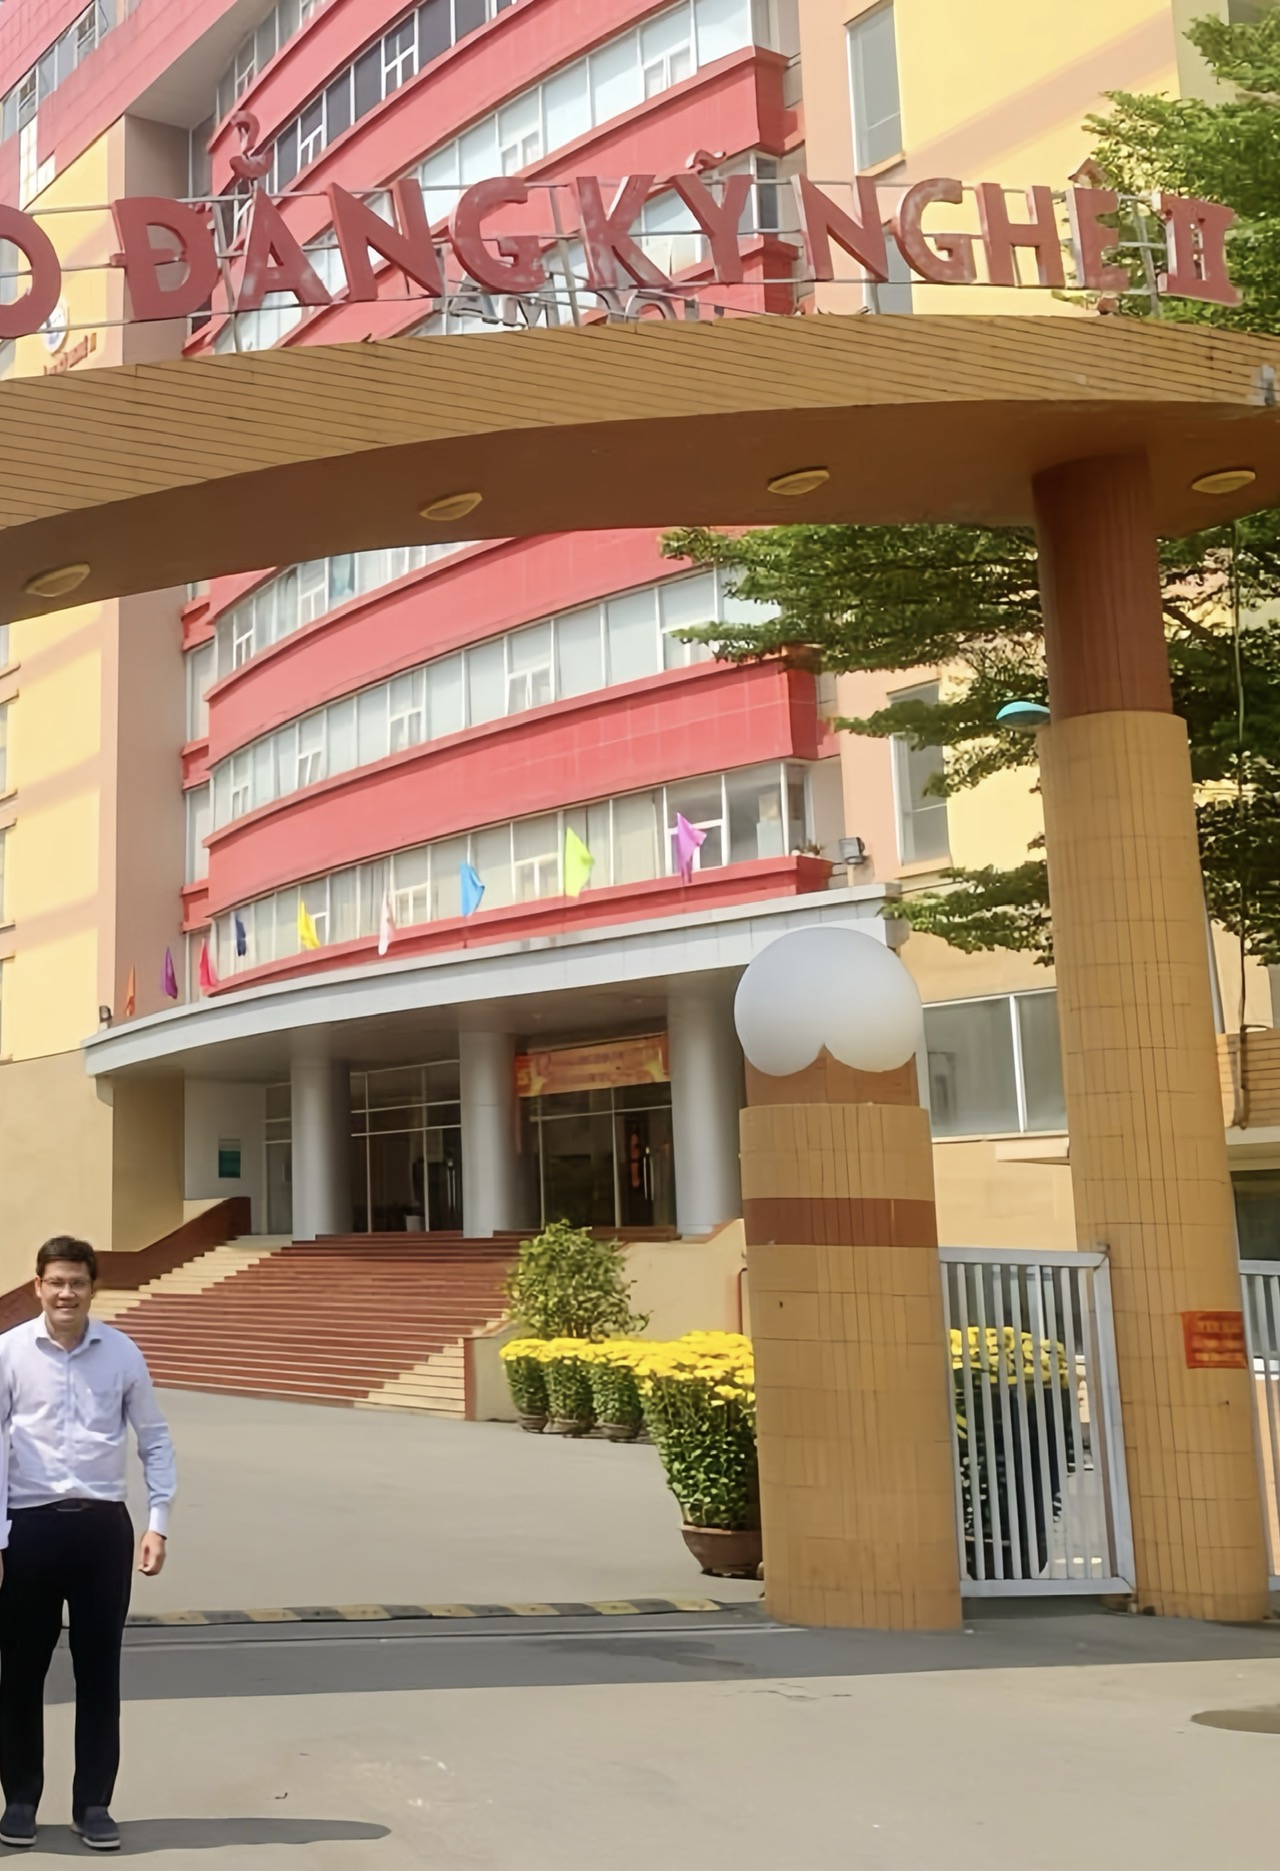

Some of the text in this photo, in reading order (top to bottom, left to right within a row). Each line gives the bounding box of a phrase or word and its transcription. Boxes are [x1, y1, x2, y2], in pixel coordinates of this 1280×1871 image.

[111, 110, 547, 320] ĐẲNG
[574, 149, 755, 290] KỸ
[791, 157, 1130, 315] NGHỆ
